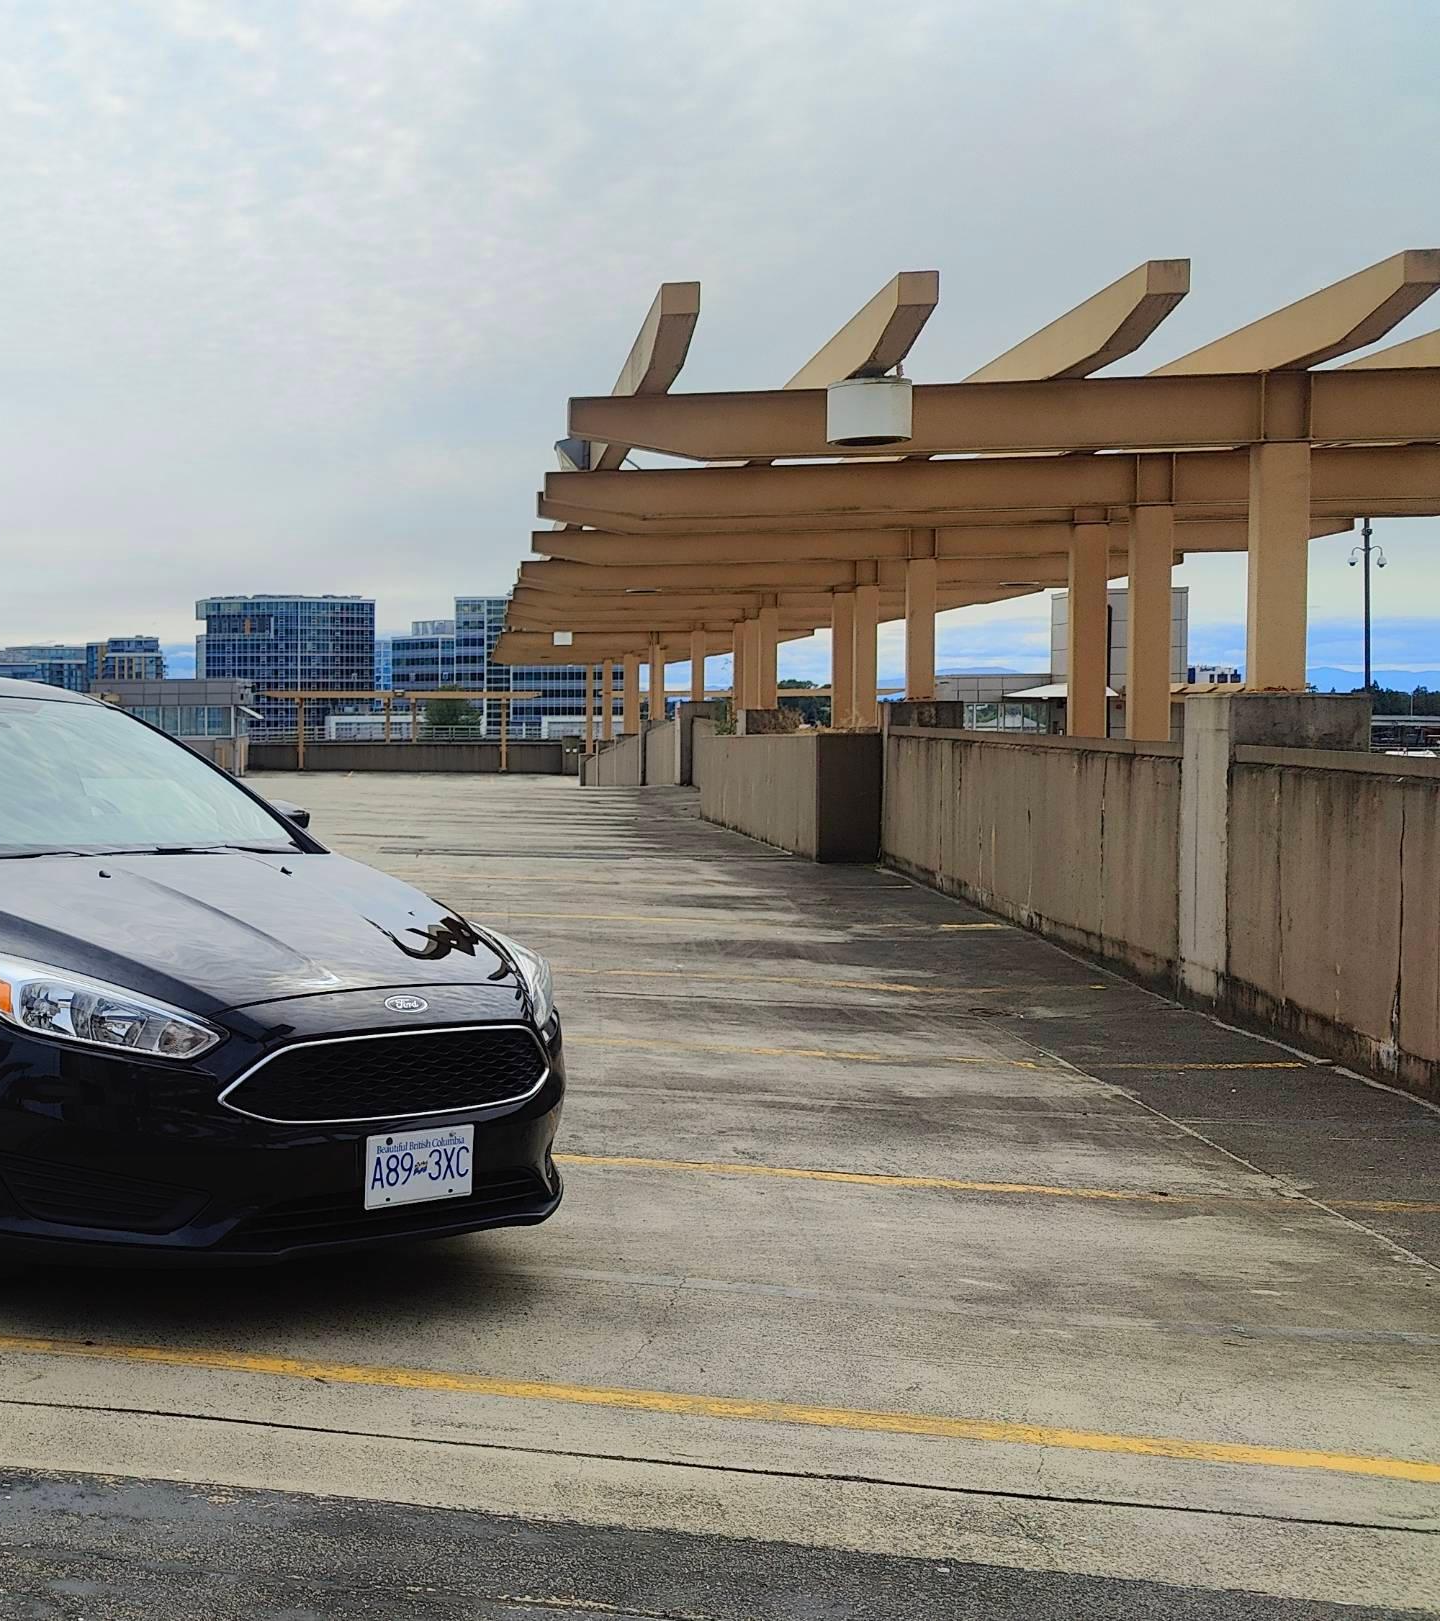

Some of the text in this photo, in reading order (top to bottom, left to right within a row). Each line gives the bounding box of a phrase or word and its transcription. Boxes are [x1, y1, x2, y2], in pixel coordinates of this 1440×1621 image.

[394, 999, 419, 1009] Ford
[376, 1136, 464, 1154] Beautiful British Columbia
[371, 1146, 469, 1190] A89 3XC
